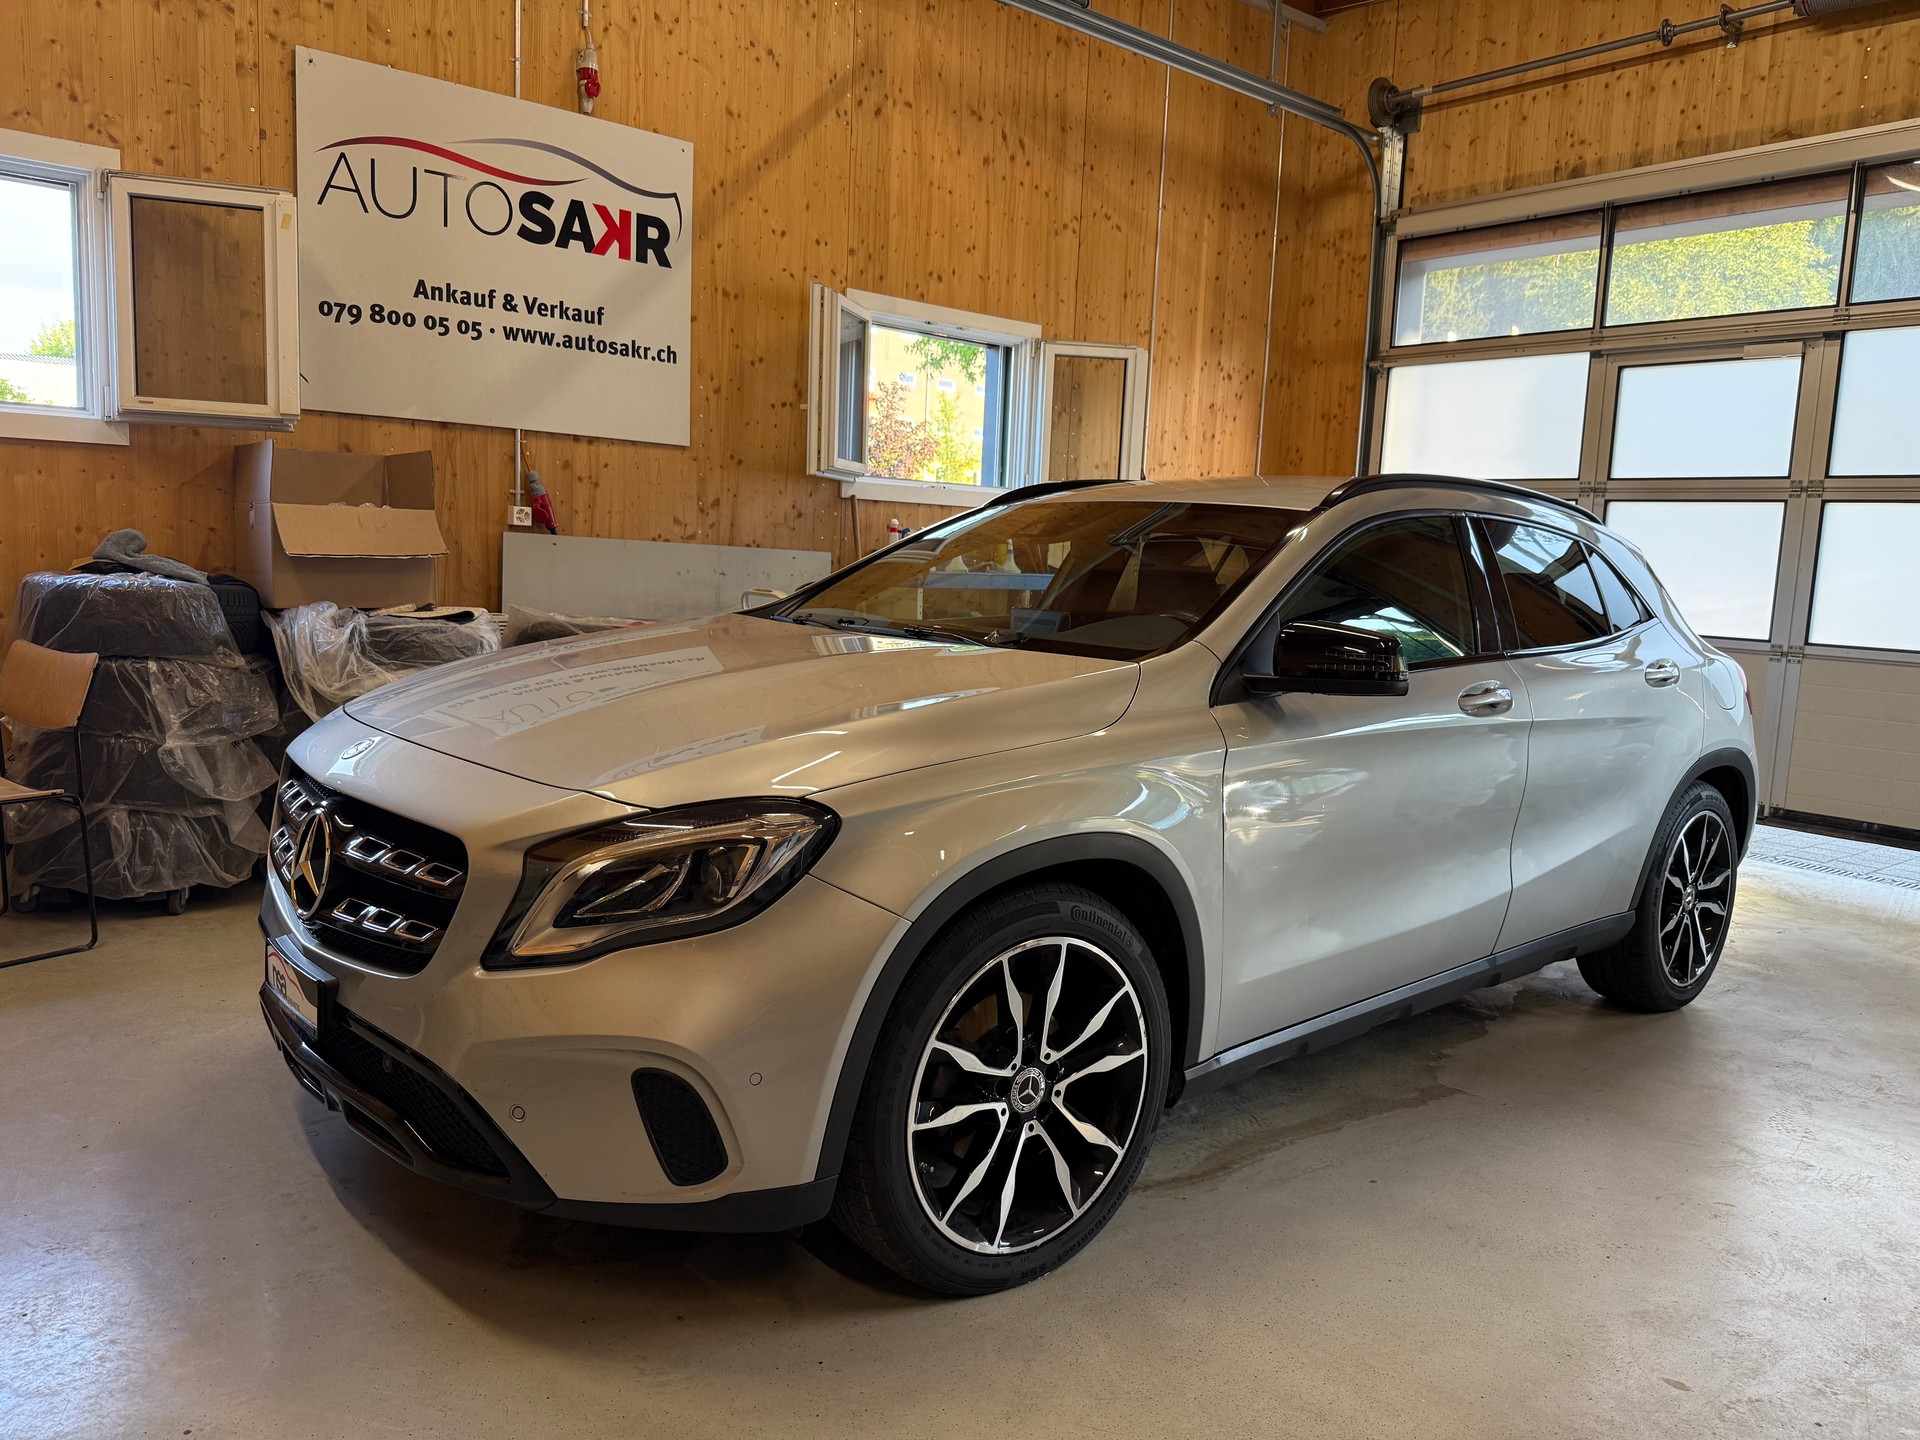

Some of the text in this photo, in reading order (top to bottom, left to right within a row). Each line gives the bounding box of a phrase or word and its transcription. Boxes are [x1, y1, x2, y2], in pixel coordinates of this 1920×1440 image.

[413, 279, 605, 326] Ankauf & Verkauf
[317, 300, 363, 326] 079
[369, 303, 417, 328] 800
[423, 316, 450, 337] 05
[456, 319, 483, 341] 05
[502, 325, 678, 365] www.autosakr.ch
[1069, 904, 1128, 945] Continental
